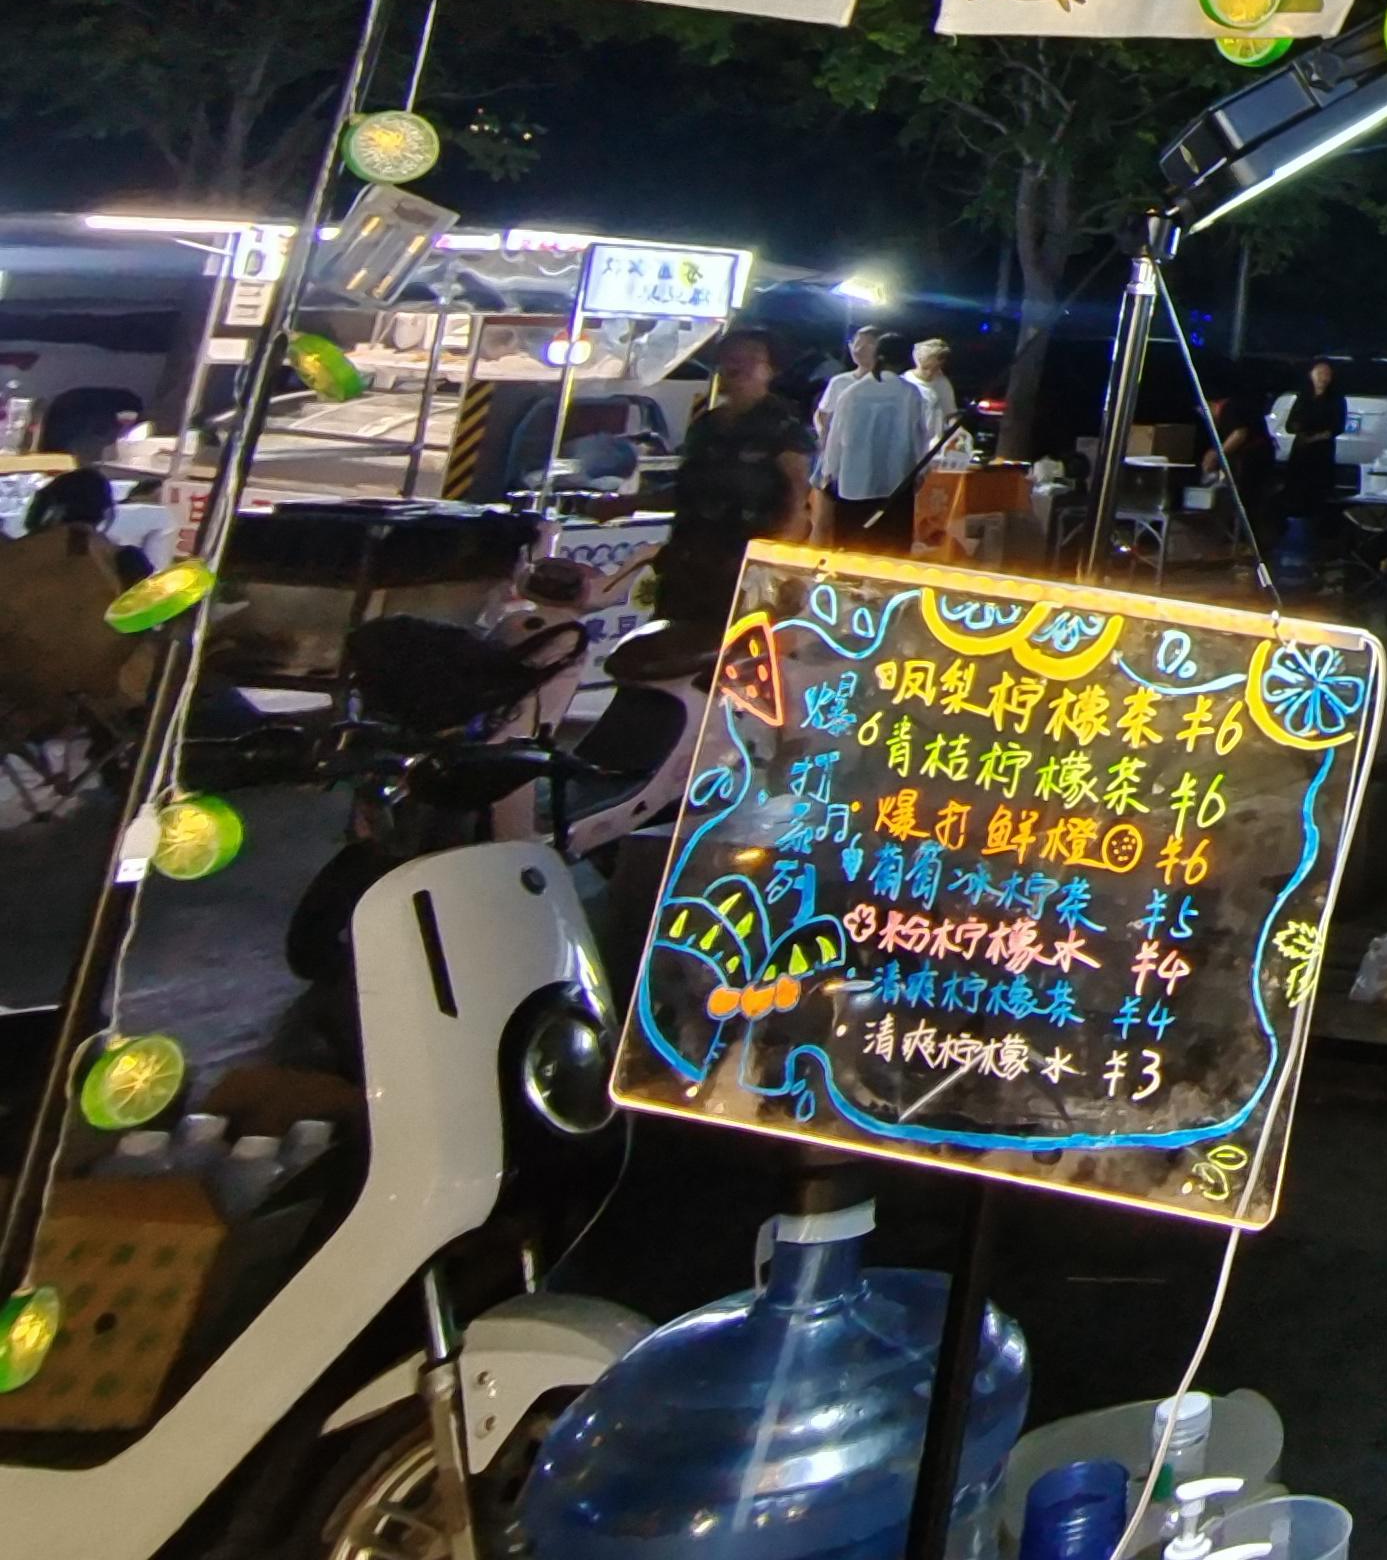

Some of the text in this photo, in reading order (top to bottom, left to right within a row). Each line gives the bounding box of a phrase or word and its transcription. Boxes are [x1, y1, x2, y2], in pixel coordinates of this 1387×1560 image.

[891, 658, 1163, 749] 凤梨柠檬茶
[885, 714, 1150, 815] 青桔柠檬茶
[874, 787, 1106, 867] 爆打鲜橙
[877, 910, 1102, 974] 粉柠檬水
[872, 958, 1086, 1028] 清爽柠檬茶
[862, 1012, 1087, 1085] 清爽柠檬水
